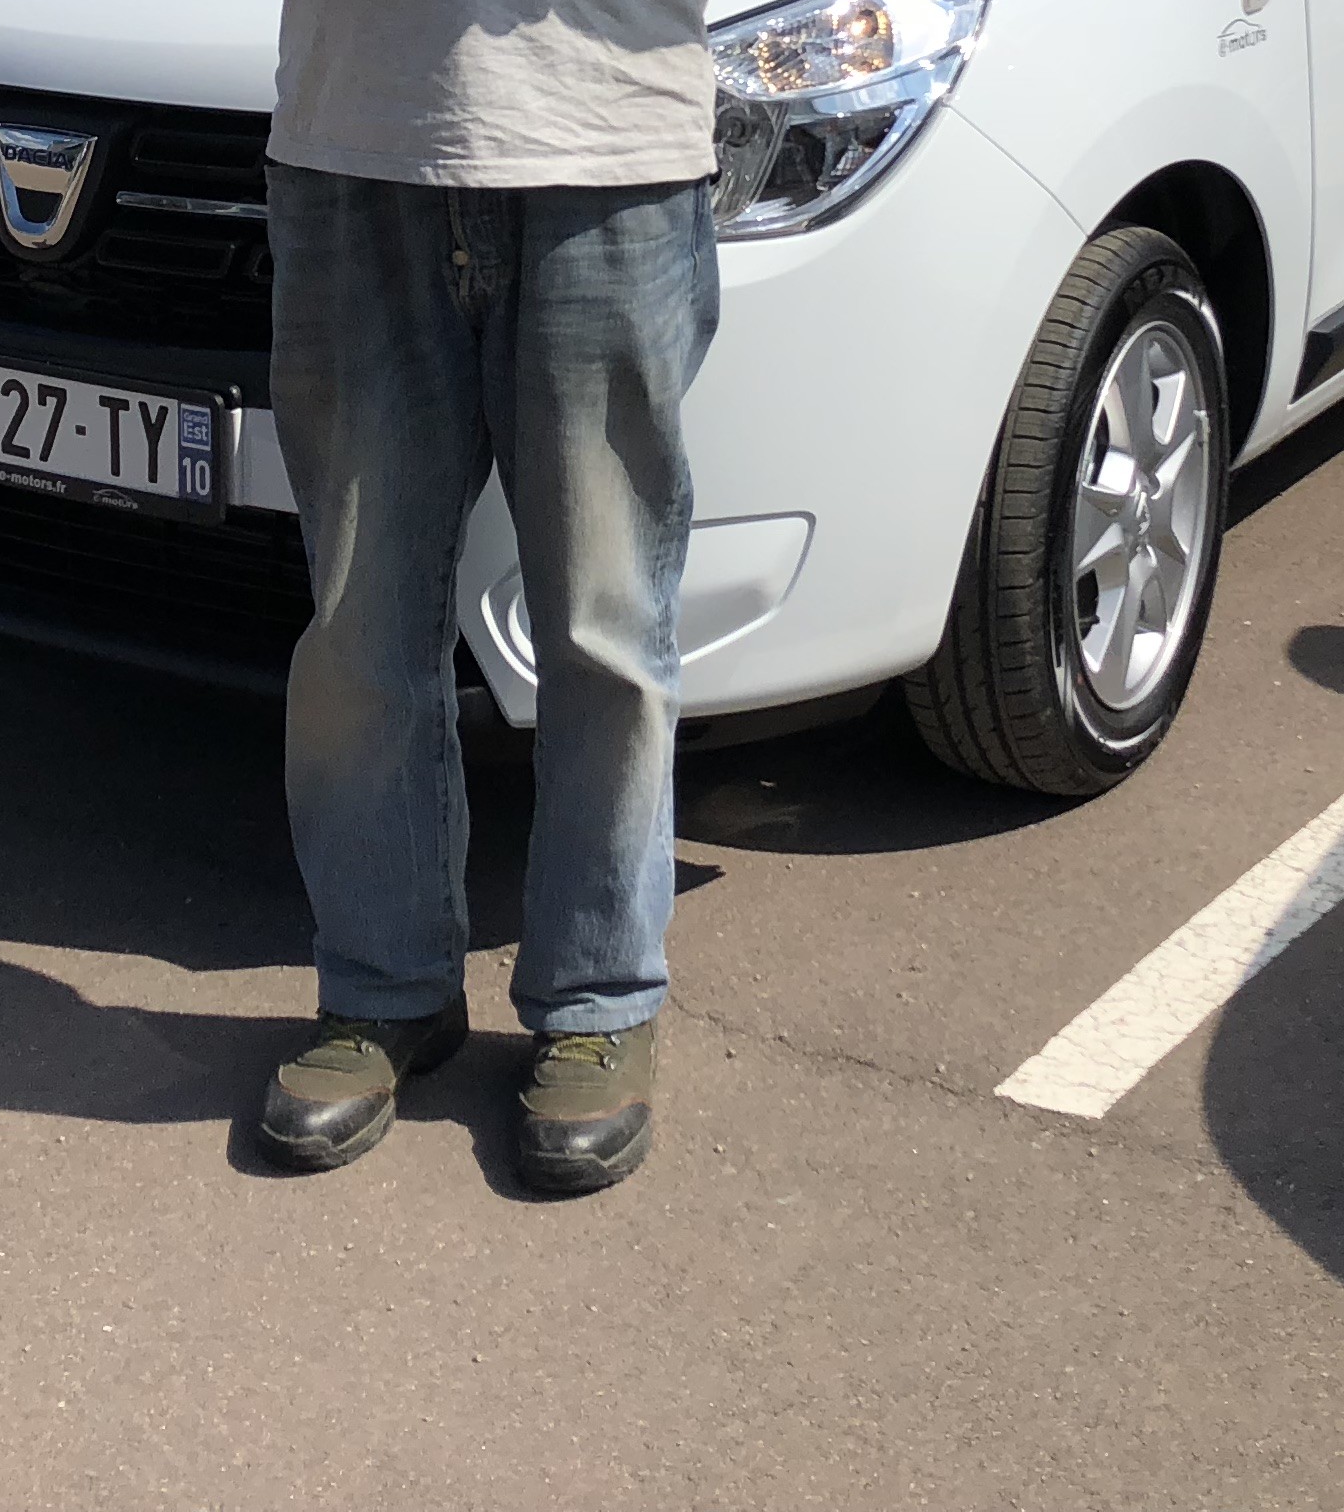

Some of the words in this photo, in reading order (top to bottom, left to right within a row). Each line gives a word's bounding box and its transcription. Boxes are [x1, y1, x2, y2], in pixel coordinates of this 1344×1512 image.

[4, 144, 71, 172] DACIA
[183, 412, 208, 424] Grand
[183, 420, 208, 442] Est
[182, 456, 210, 496] 10
